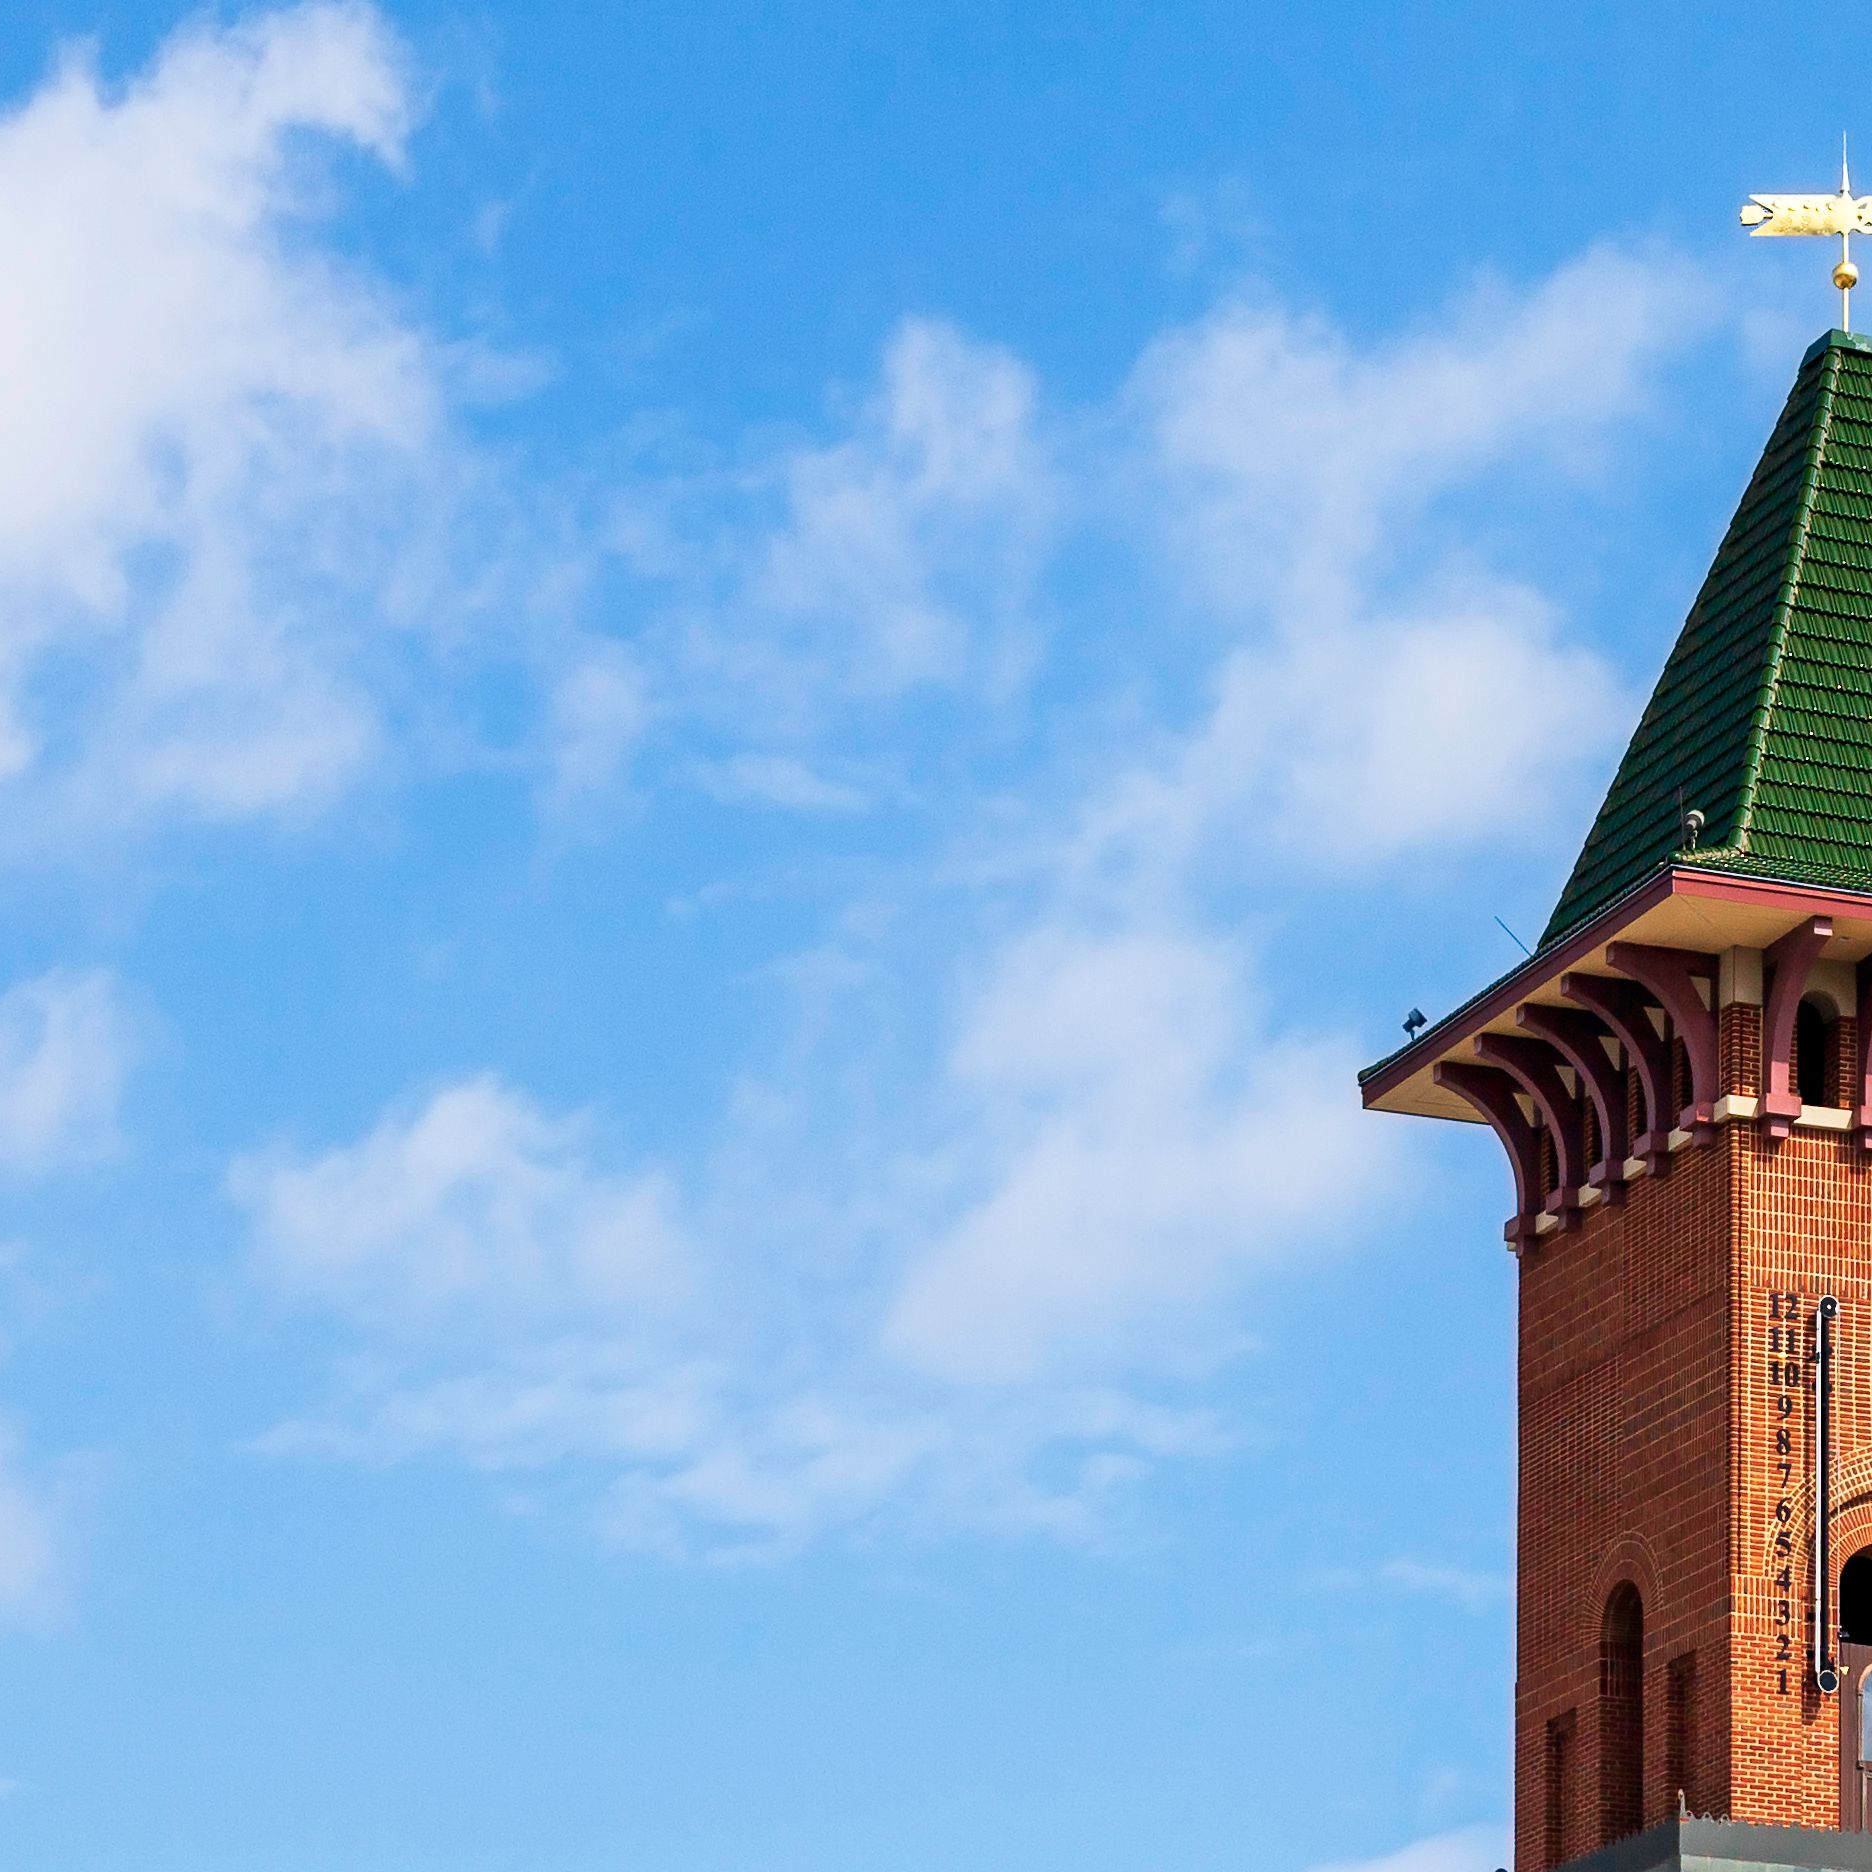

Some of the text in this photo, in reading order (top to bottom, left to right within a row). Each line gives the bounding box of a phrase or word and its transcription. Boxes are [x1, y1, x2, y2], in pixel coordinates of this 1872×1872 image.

[1769, 1293, 1798, 1319] 12
[1769, 1327, 1795, 1350] 11
[1769, 1361, 1799, 1386] 10
[1777, 1394, 1792, 1419] 9
[1776, 1429, 1790, 1455] 8
[1778, 1463, 1791, 1488] 7
[1776, 1497, 1790, 1522] 6
[1777, 1531, 1791, 1557] 5
[1776, 1565, 1791, 1592] 4
[1776, 1600, 1790, 1626] 3
[1776, 1635, 1790, 1659] 2
[1778, 1669, 1789, 1694] 1
